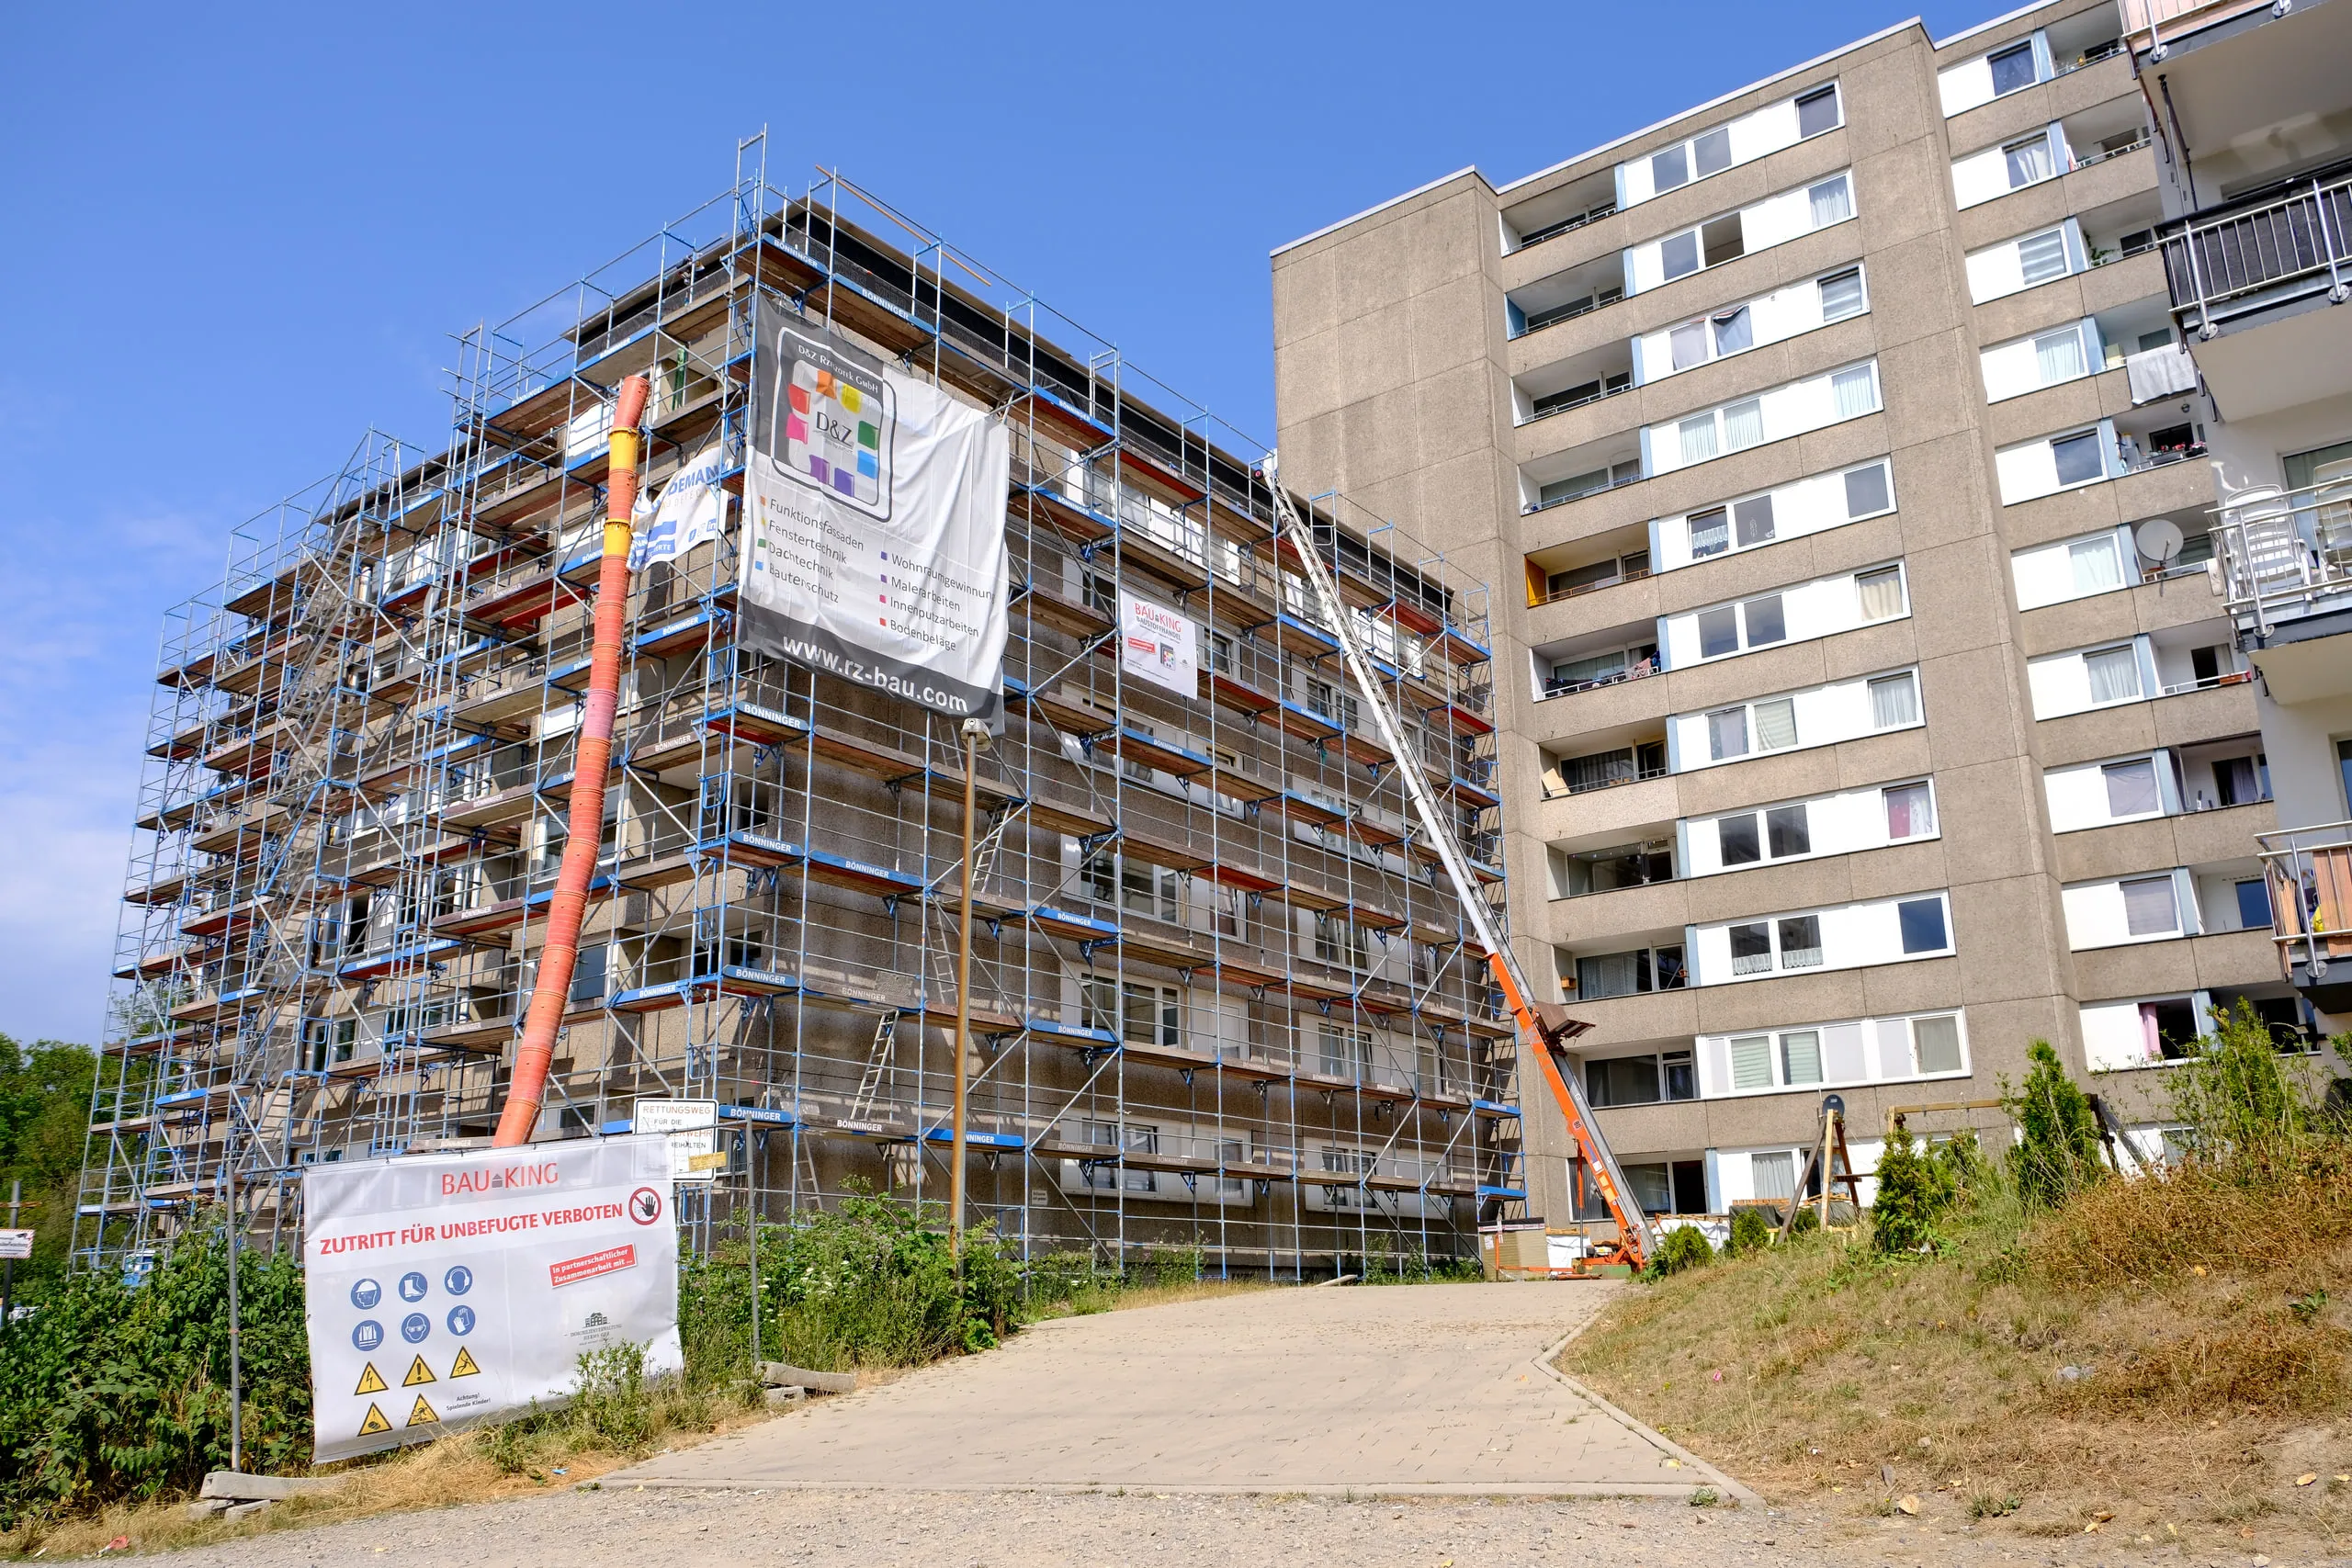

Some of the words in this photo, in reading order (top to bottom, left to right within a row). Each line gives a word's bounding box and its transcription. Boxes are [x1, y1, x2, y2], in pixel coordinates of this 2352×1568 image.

[798, 344, 817, 361] D&Z
[856, 376, 878, 394] GmbH
[816, 412, 853, 447] D&Z
[770, 498, 864, 551] Funktionsfassaden
[769, 520, 847, 564] Fenstertechnik
[769, 542, 834, 580] Dachtechnik
[769, 563, 838, 603] Bautenschutz
[891, 576, 960, 612] Malerarbeiten
[662, 616, 699, 635] BÖNNINGER
[890, 597, 979, 637] Innenputzarbeiten
[1135, 603, 1154, 621] BAU
[1159, 613, 1182, 632] KING
[890, 619, 956, 651] Bodenbeläge
[783, 636, 968, 713] www.rz-bau.com
[845, 860, 889, 878] BÖNNINGER
[1057, 912, 1091, 927] BÖNNINGER
[735, 968, 786, 985] BÖNNINGER
[1057, 1025, 1093, 1037] BÖNNINGER
[643, 1105, 711, 1114] RETTUNGSWEG
[441, 1169, 490, 1196] BAU
[505, 1162, 558, 1188] KING
[321, 1231, 396, 1255] ZUTRITT
[401, 1223, 435, 1245] FÜR
[441, 1213, 538, 1240] UNBEFUGTE
[543, 1203, 623, 1226] VERBOTEN
[554, 1262, 612, 1283] Zusammenarbeit
[561, 1249, 628, 1273] partnerschaftlicher
[447, 1402, 470, 1411] Spielende
